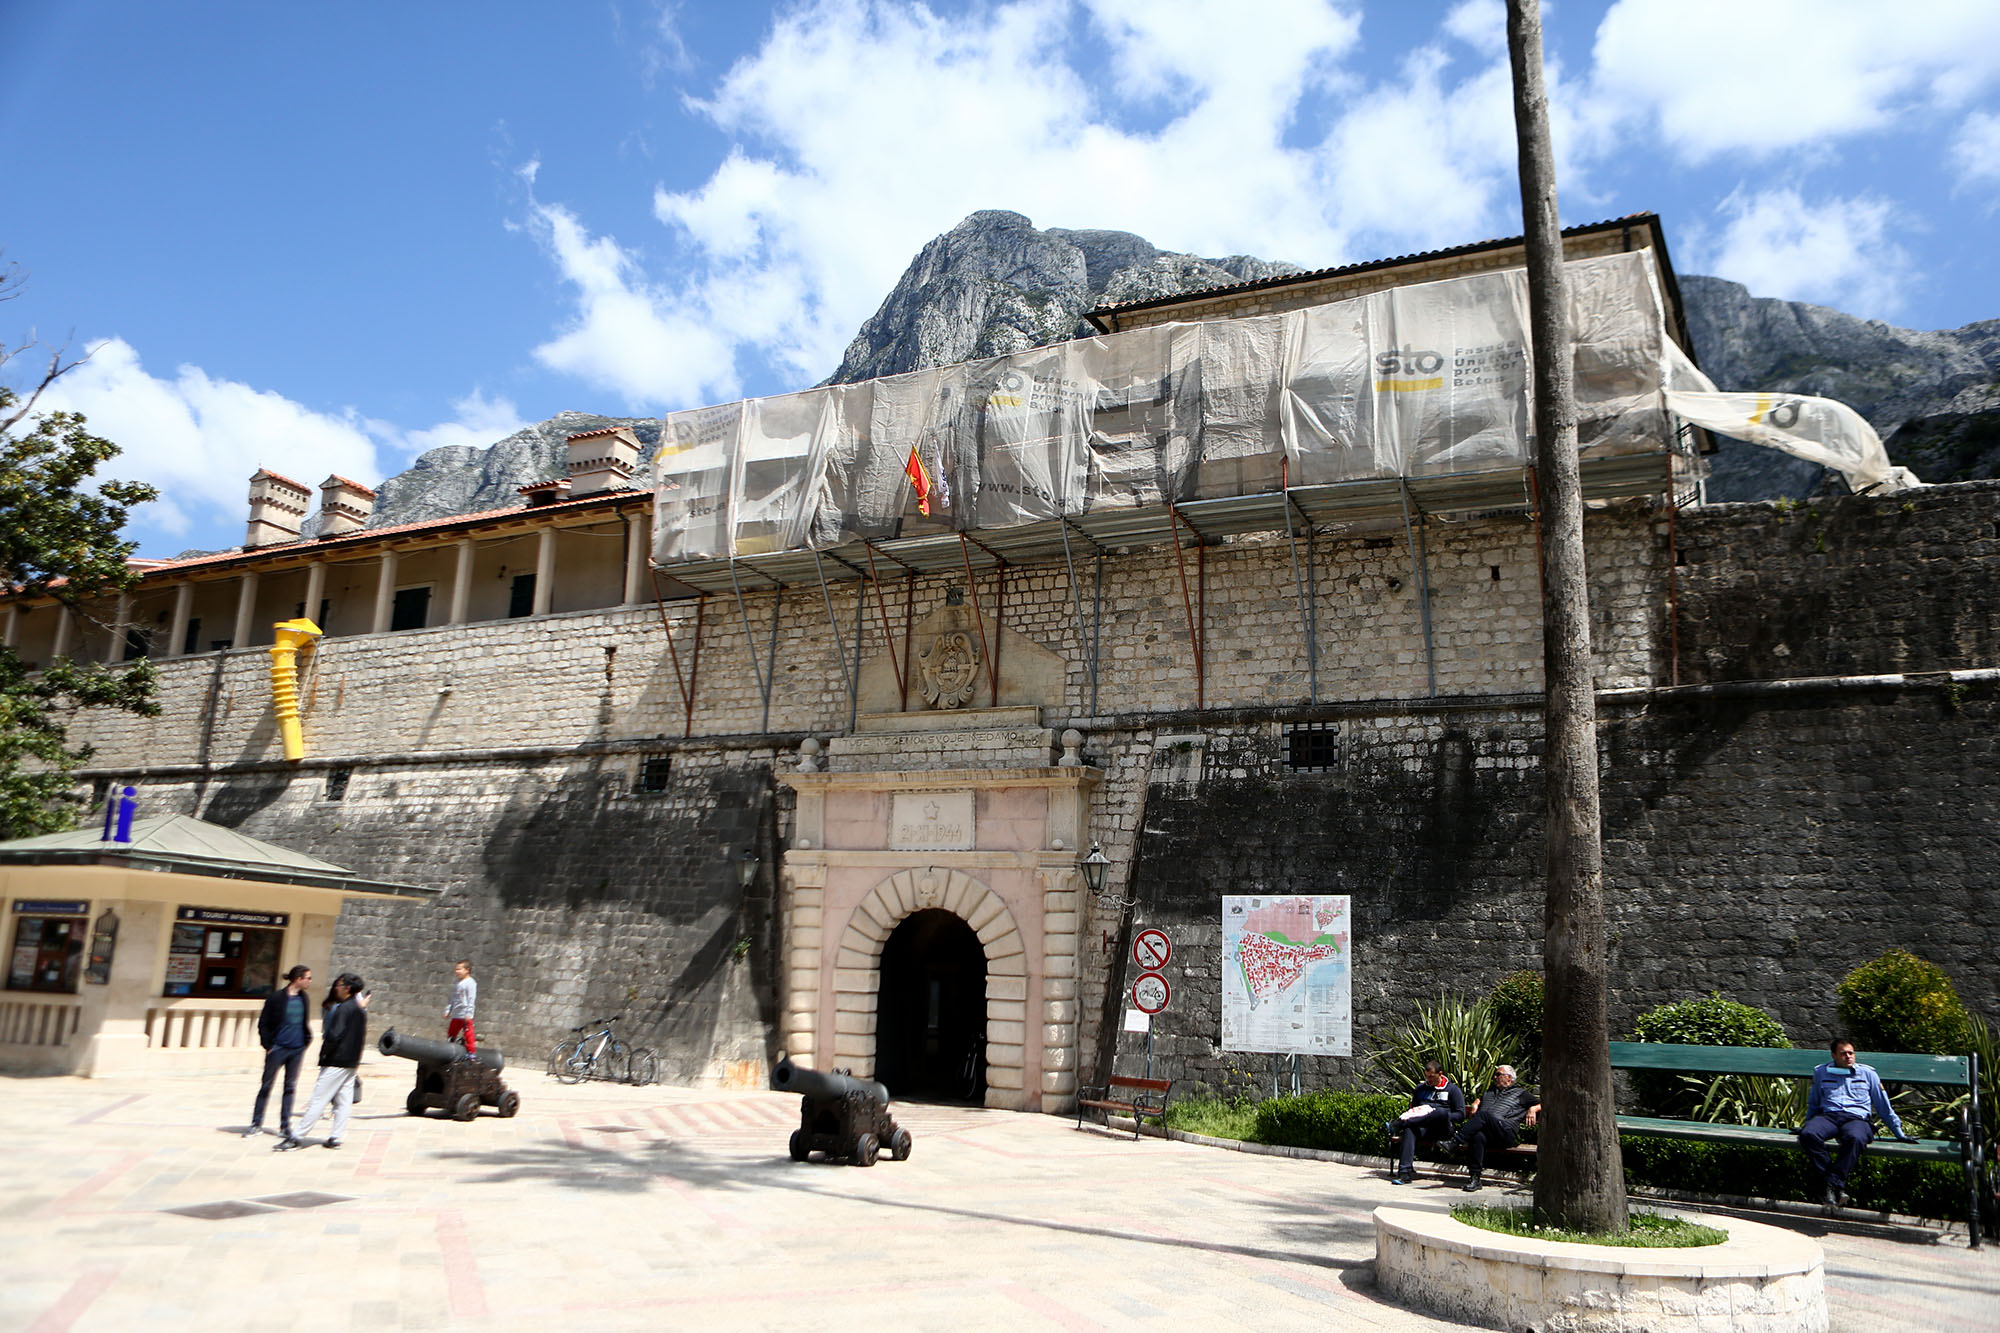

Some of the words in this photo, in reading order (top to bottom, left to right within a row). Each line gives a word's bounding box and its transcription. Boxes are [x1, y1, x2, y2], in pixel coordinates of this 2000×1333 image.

[1455, 340, 1516, 356] Fasade
[1376, 344, 1444, 375] sto
[1454, 360, 1517, 377] prostor
[1454, 375, 1504, 387] Beton
[201, 911, 229, 919] TOURIST
[230, 913, 270, 922] INFORMATION
